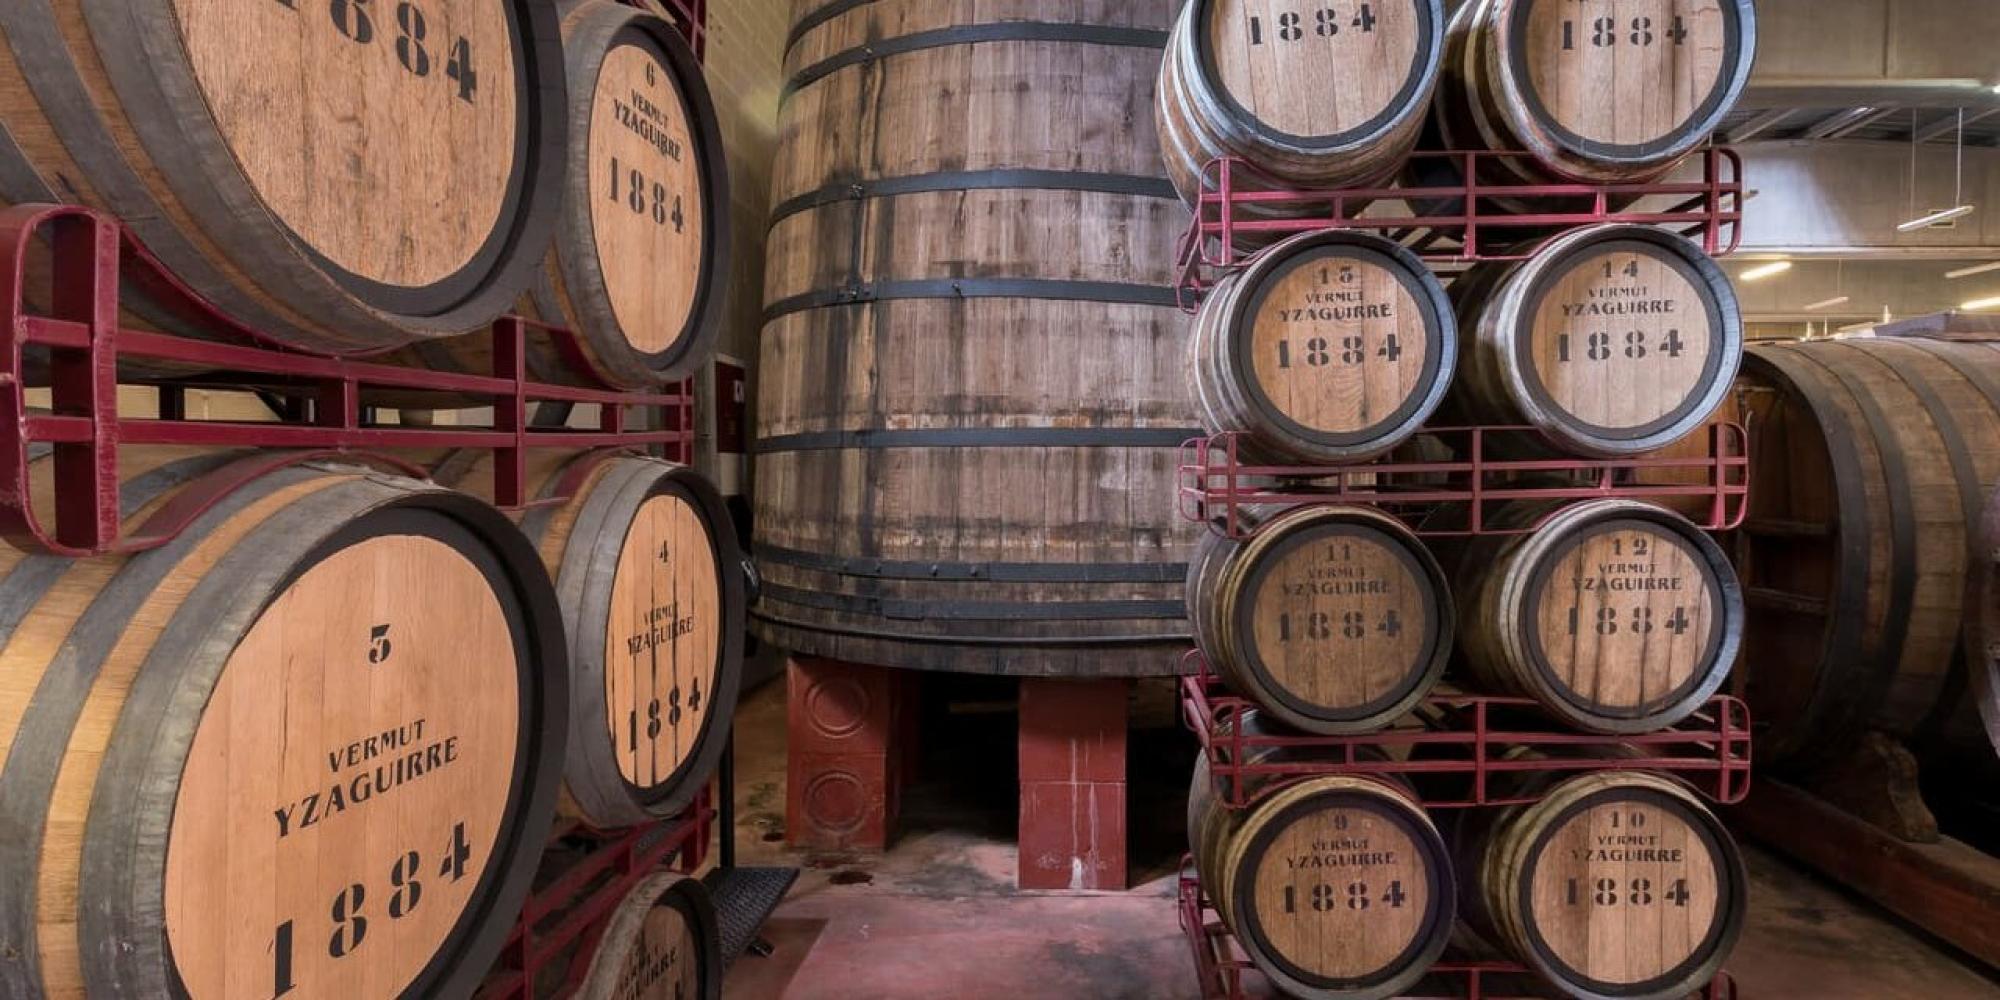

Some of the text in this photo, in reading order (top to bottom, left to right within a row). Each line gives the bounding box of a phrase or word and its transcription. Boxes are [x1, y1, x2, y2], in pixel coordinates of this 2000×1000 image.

[1250, 3, 1376, 45] 1884
[1563, 15, 1687, 49] 1884
[275, 0, 477, 104] 884
[631, 88, 668, 129] VERMUT
[613, 98, 682, 163] YZAGUIRRE
[610, 157, 684, 234] 1884
[1602, 260, 1638, 277] 14
[1306, 290, 1363, 303] VERMUT
[1588, 286, 1648, 297] VERMUT
[1279, 303, 1392, 321] YZAGUIRRE
[1562, 300, 1674, 316] YZAGUIRRE
[1278, 333, 1403, 368] 1884
[1558, 329, 1683, 361] 1884
[659, 540, 669, 563] 4
[1327, 543, 1350, 561] 11
[1612, 537, 1648, 556] 12
[1308, 566, 1365, 578] VERMUT
[1599, 564, 1658, 573] VERMUT
[1281, 580, 1392, 596] YZAGUIRRE
[1571, 577, 1683, 591] YZAGUIRRE
[1279, 609, 1402, 642] 1884
[1568, 607, 1689, 635] 1884
[627, 617, 693, 656] YZAGUIRRE
[629, 676, 701, 753] 1884
[329, 718, 426, 773] VERMUT
[274, 736, 459, 838] YZAGUIRRE
[1611, 810, 1646, 828] 10
[1311, 839, 1369, 850] VERMUT
[1597, 835, 1659, 846] VERMUT
[1286, 851, 1396, 869] YZAGUIRRE
[1571, 849, 1682, 862] YZAGUIRRE
[1284, 880, 1406, 914] 1884
[1566, 878, 1690, 907] 1884
[266, 821, 472, 1000] 1884
